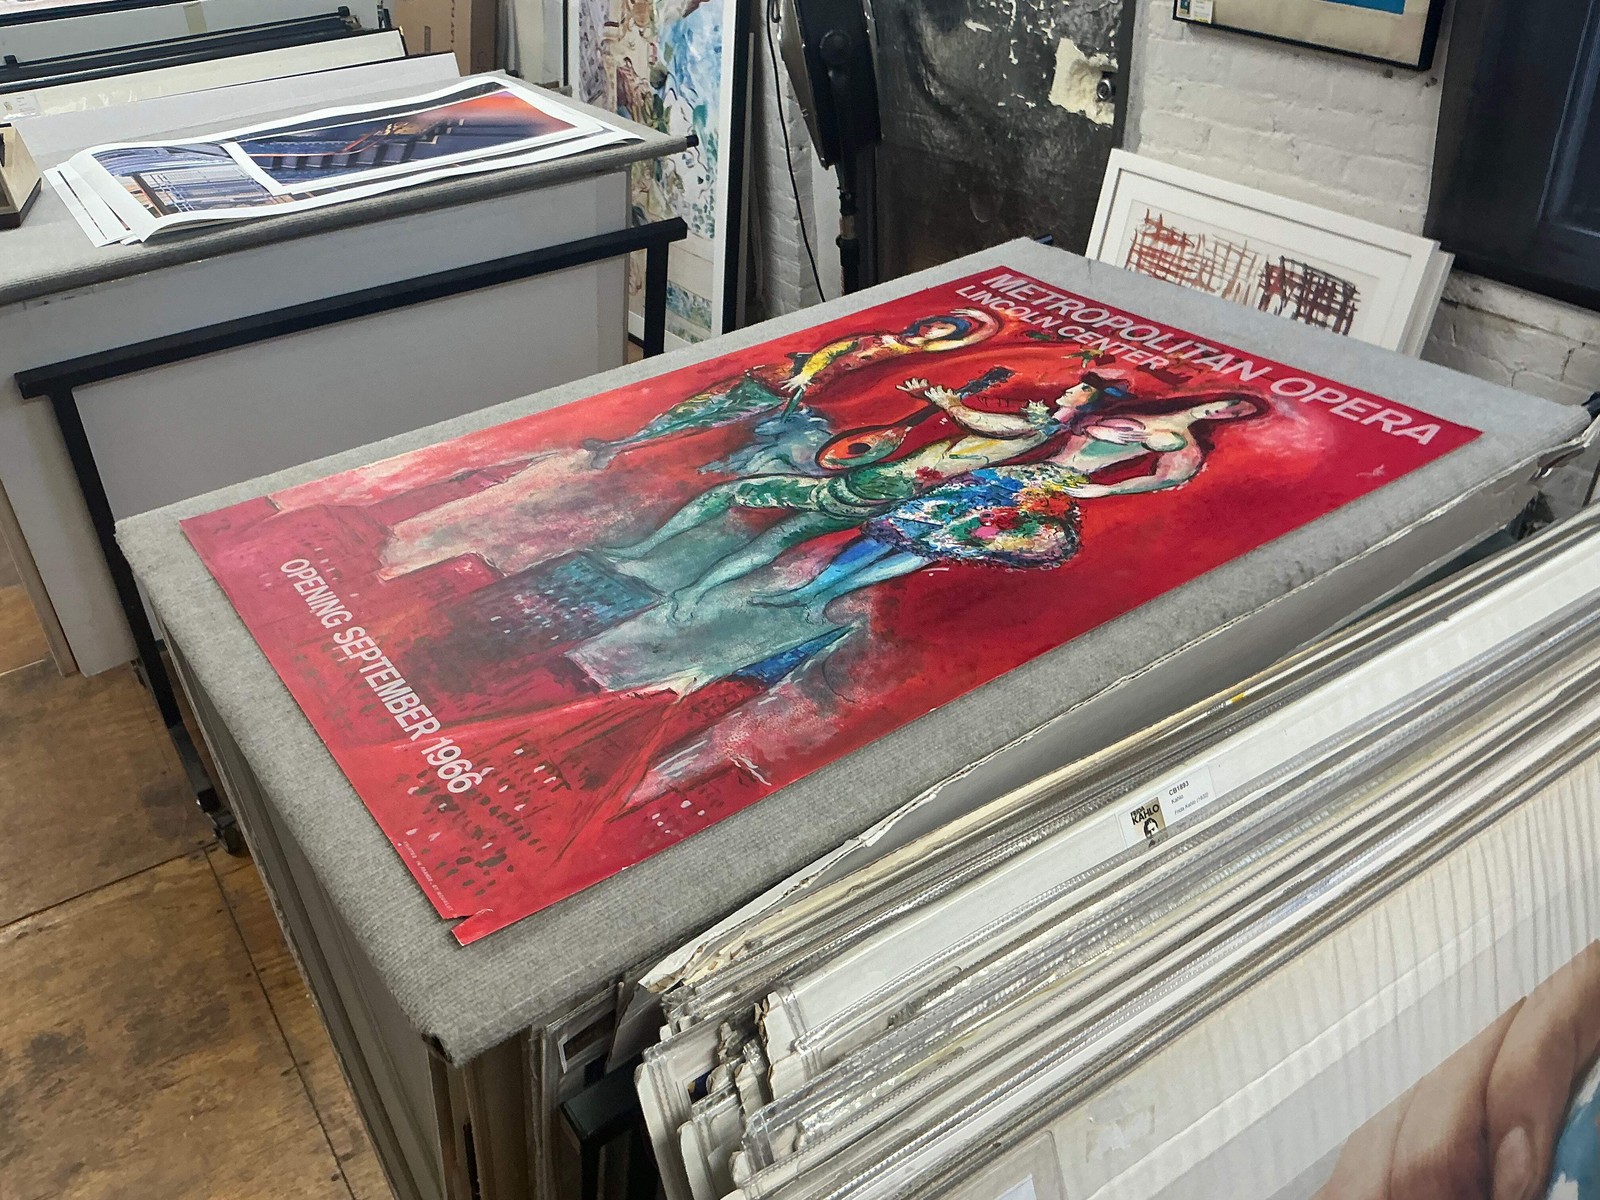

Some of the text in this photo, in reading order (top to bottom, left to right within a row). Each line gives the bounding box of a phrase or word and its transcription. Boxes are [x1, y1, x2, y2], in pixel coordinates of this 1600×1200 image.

[955, 285, 1170, 371] LINCOLN CENTER
[981, 273, 1441, 446] METROPOLITAN OPERA
[280, 558, 483, 794] OPENING SEPTEMBER 1966
[1130, 805, 1146, 817] FRIDA
[1131, 803, 1160, 825] KAHLO
